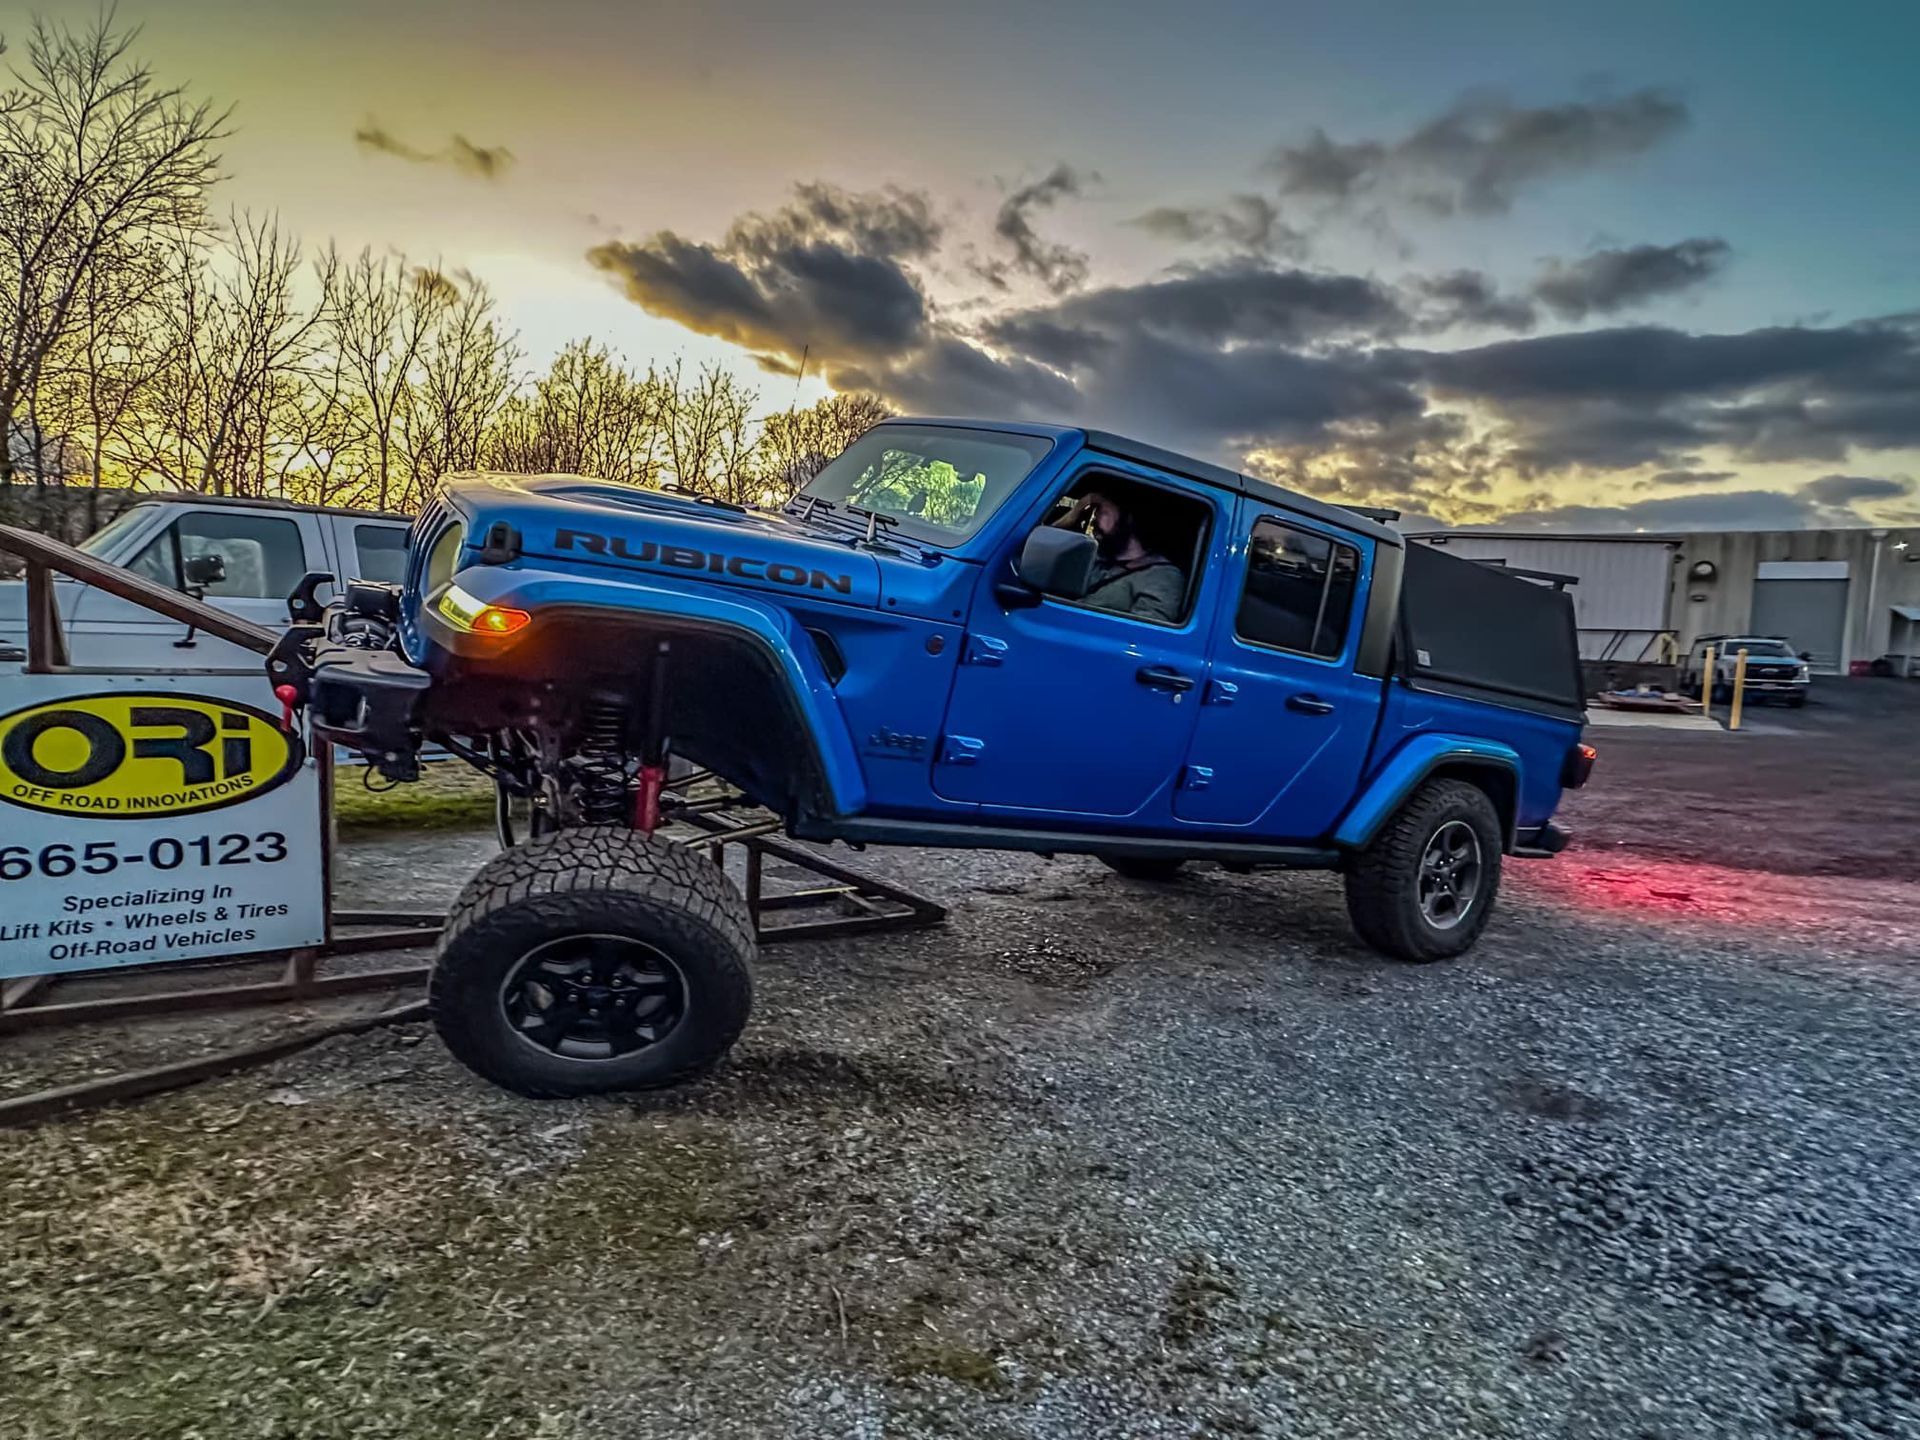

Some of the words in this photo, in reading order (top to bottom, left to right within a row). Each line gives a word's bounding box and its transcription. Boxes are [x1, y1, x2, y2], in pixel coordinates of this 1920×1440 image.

[554, 527, 853, 595] RUBICON
[13, 784, 54, 802] OFF
[60, 793, 119, 809] ROAD
[127, 775, 253, 809] INNOVATIONS
[0, 832, 288, 880] 665-0123
[63, 887, 204, 914] Specializing
[213, 885, 232, 899] In
[0, 923, 39, 941] Lift
[48, 920, 94, 937] Kits
[125, 909, 206, 929] Wheels
[214, 906, 229, 921] &
[237, 902, 288, 919] Tires
[50, 936, 156, 960] Off-Road
[164, 927, 256, 949] Vehicles
